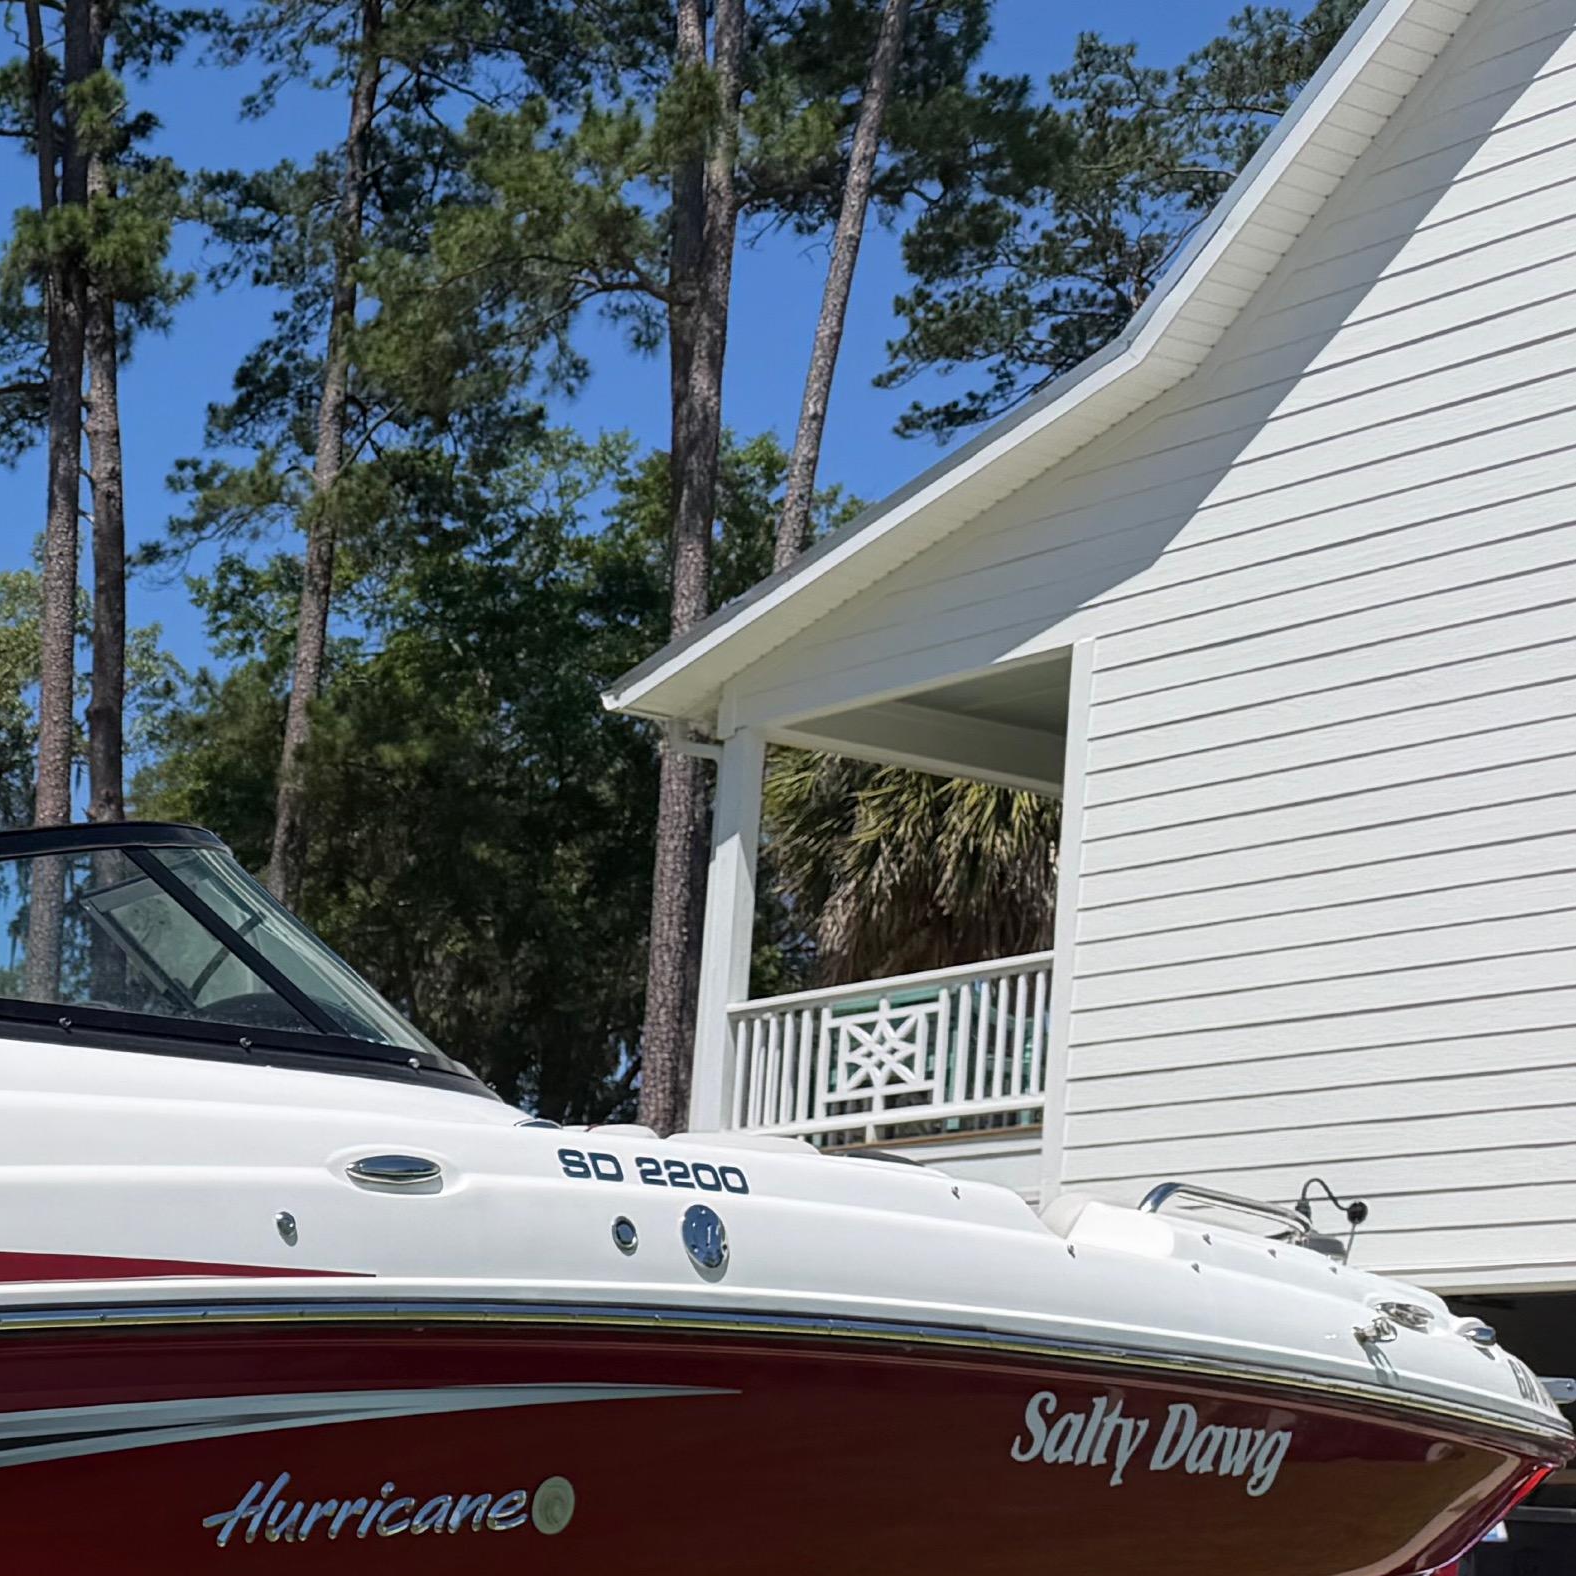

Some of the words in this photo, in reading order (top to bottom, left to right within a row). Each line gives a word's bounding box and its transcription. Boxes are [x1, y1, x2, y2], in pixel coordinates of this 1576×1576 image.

[557, 1148, 624, 1182] SD
[635, 1156, 750, 1195] 2200
[1011, 1391, 1149, 1486] Salty
[1150, 1403, 1292, 1497] Dawg
[202, 1471, 528, 1548] Hurricane
